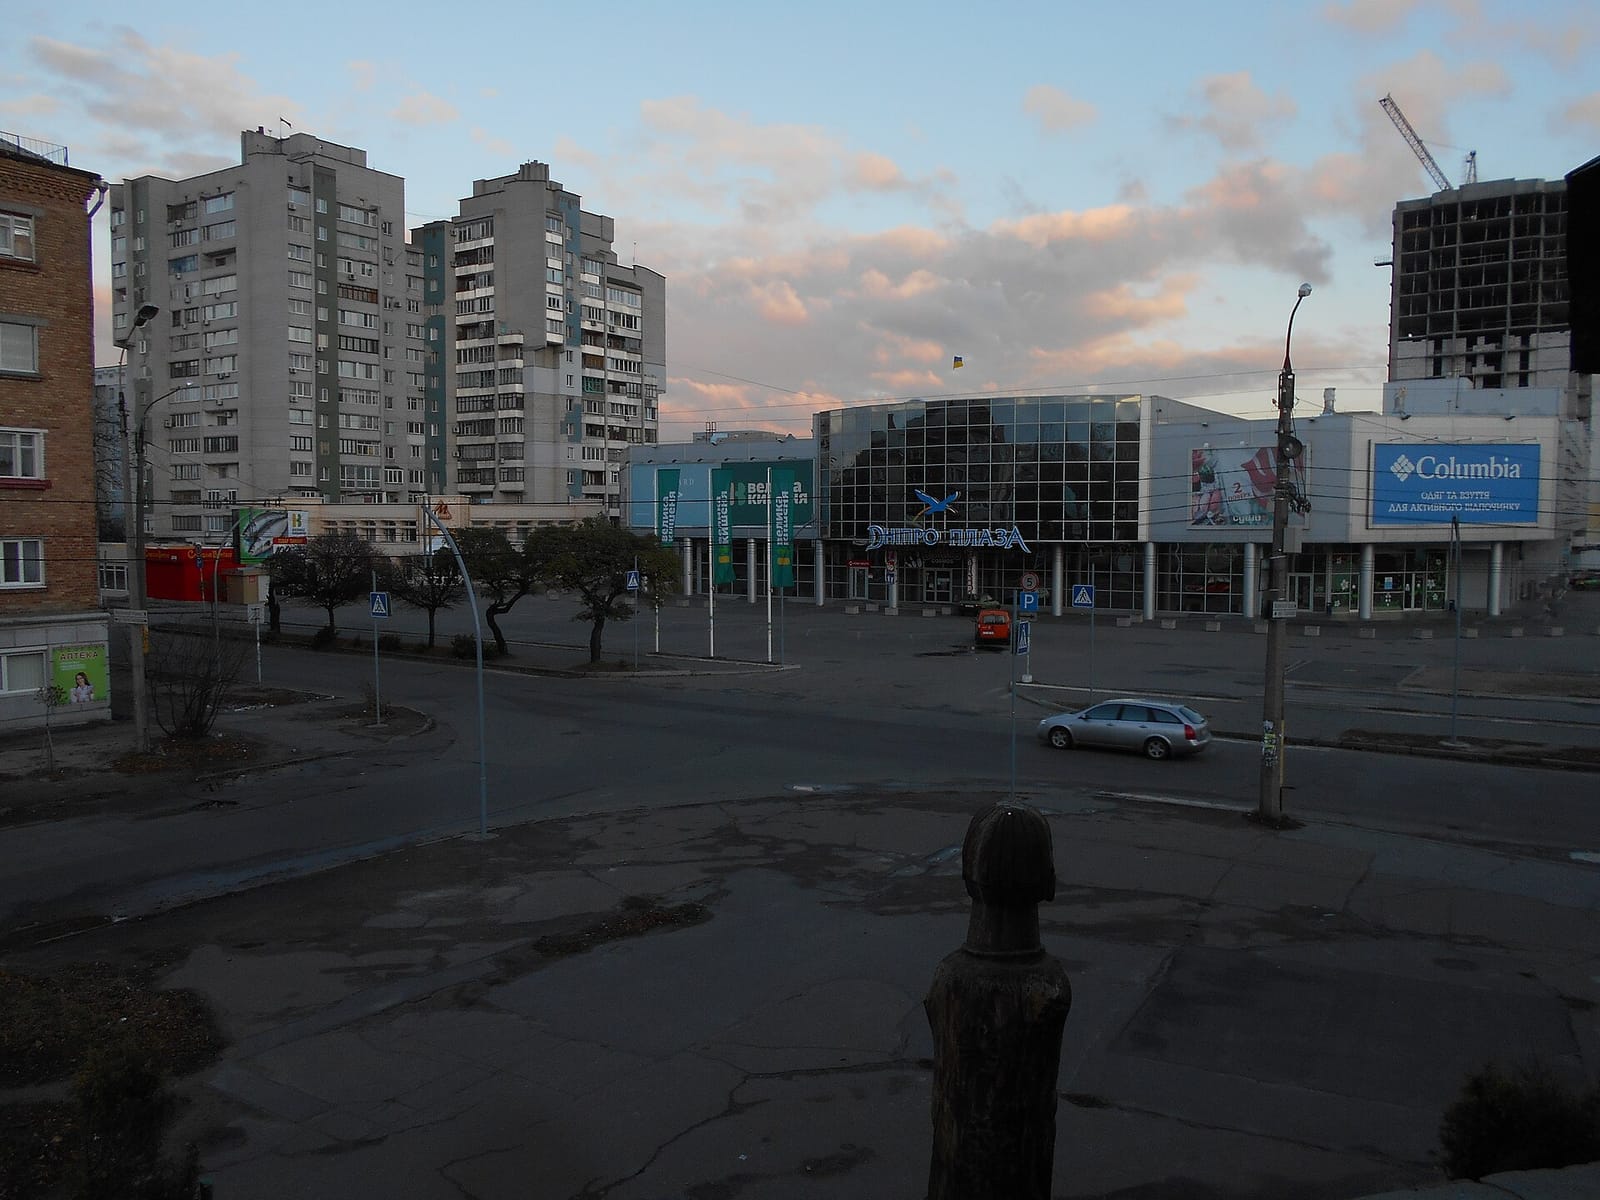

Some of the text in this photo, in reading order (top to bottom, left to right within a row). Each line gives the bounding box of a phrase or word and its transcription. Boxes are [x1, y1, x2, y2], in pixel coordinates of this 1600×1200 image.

[1416, 455, 1521, 480] Columbia
[747, 481, 802, 494] вела
[1232, 482, 1243, 493] 2
[1421, 491, 1490, 500] ОДЯГ ТА ВЗУТТЯ
[1388, 503, 1408, 513] ДЛЯ
[1411, 502, 1463, 512] АКТИВНОГО
[865, 524, 1032, 554] ДНІПРО ПЛАЗА
[1026, 577, 1033, 587] 5
[1023, 593, 1035, 609] P
[60, 651, 98, 661] АПТЕКА
